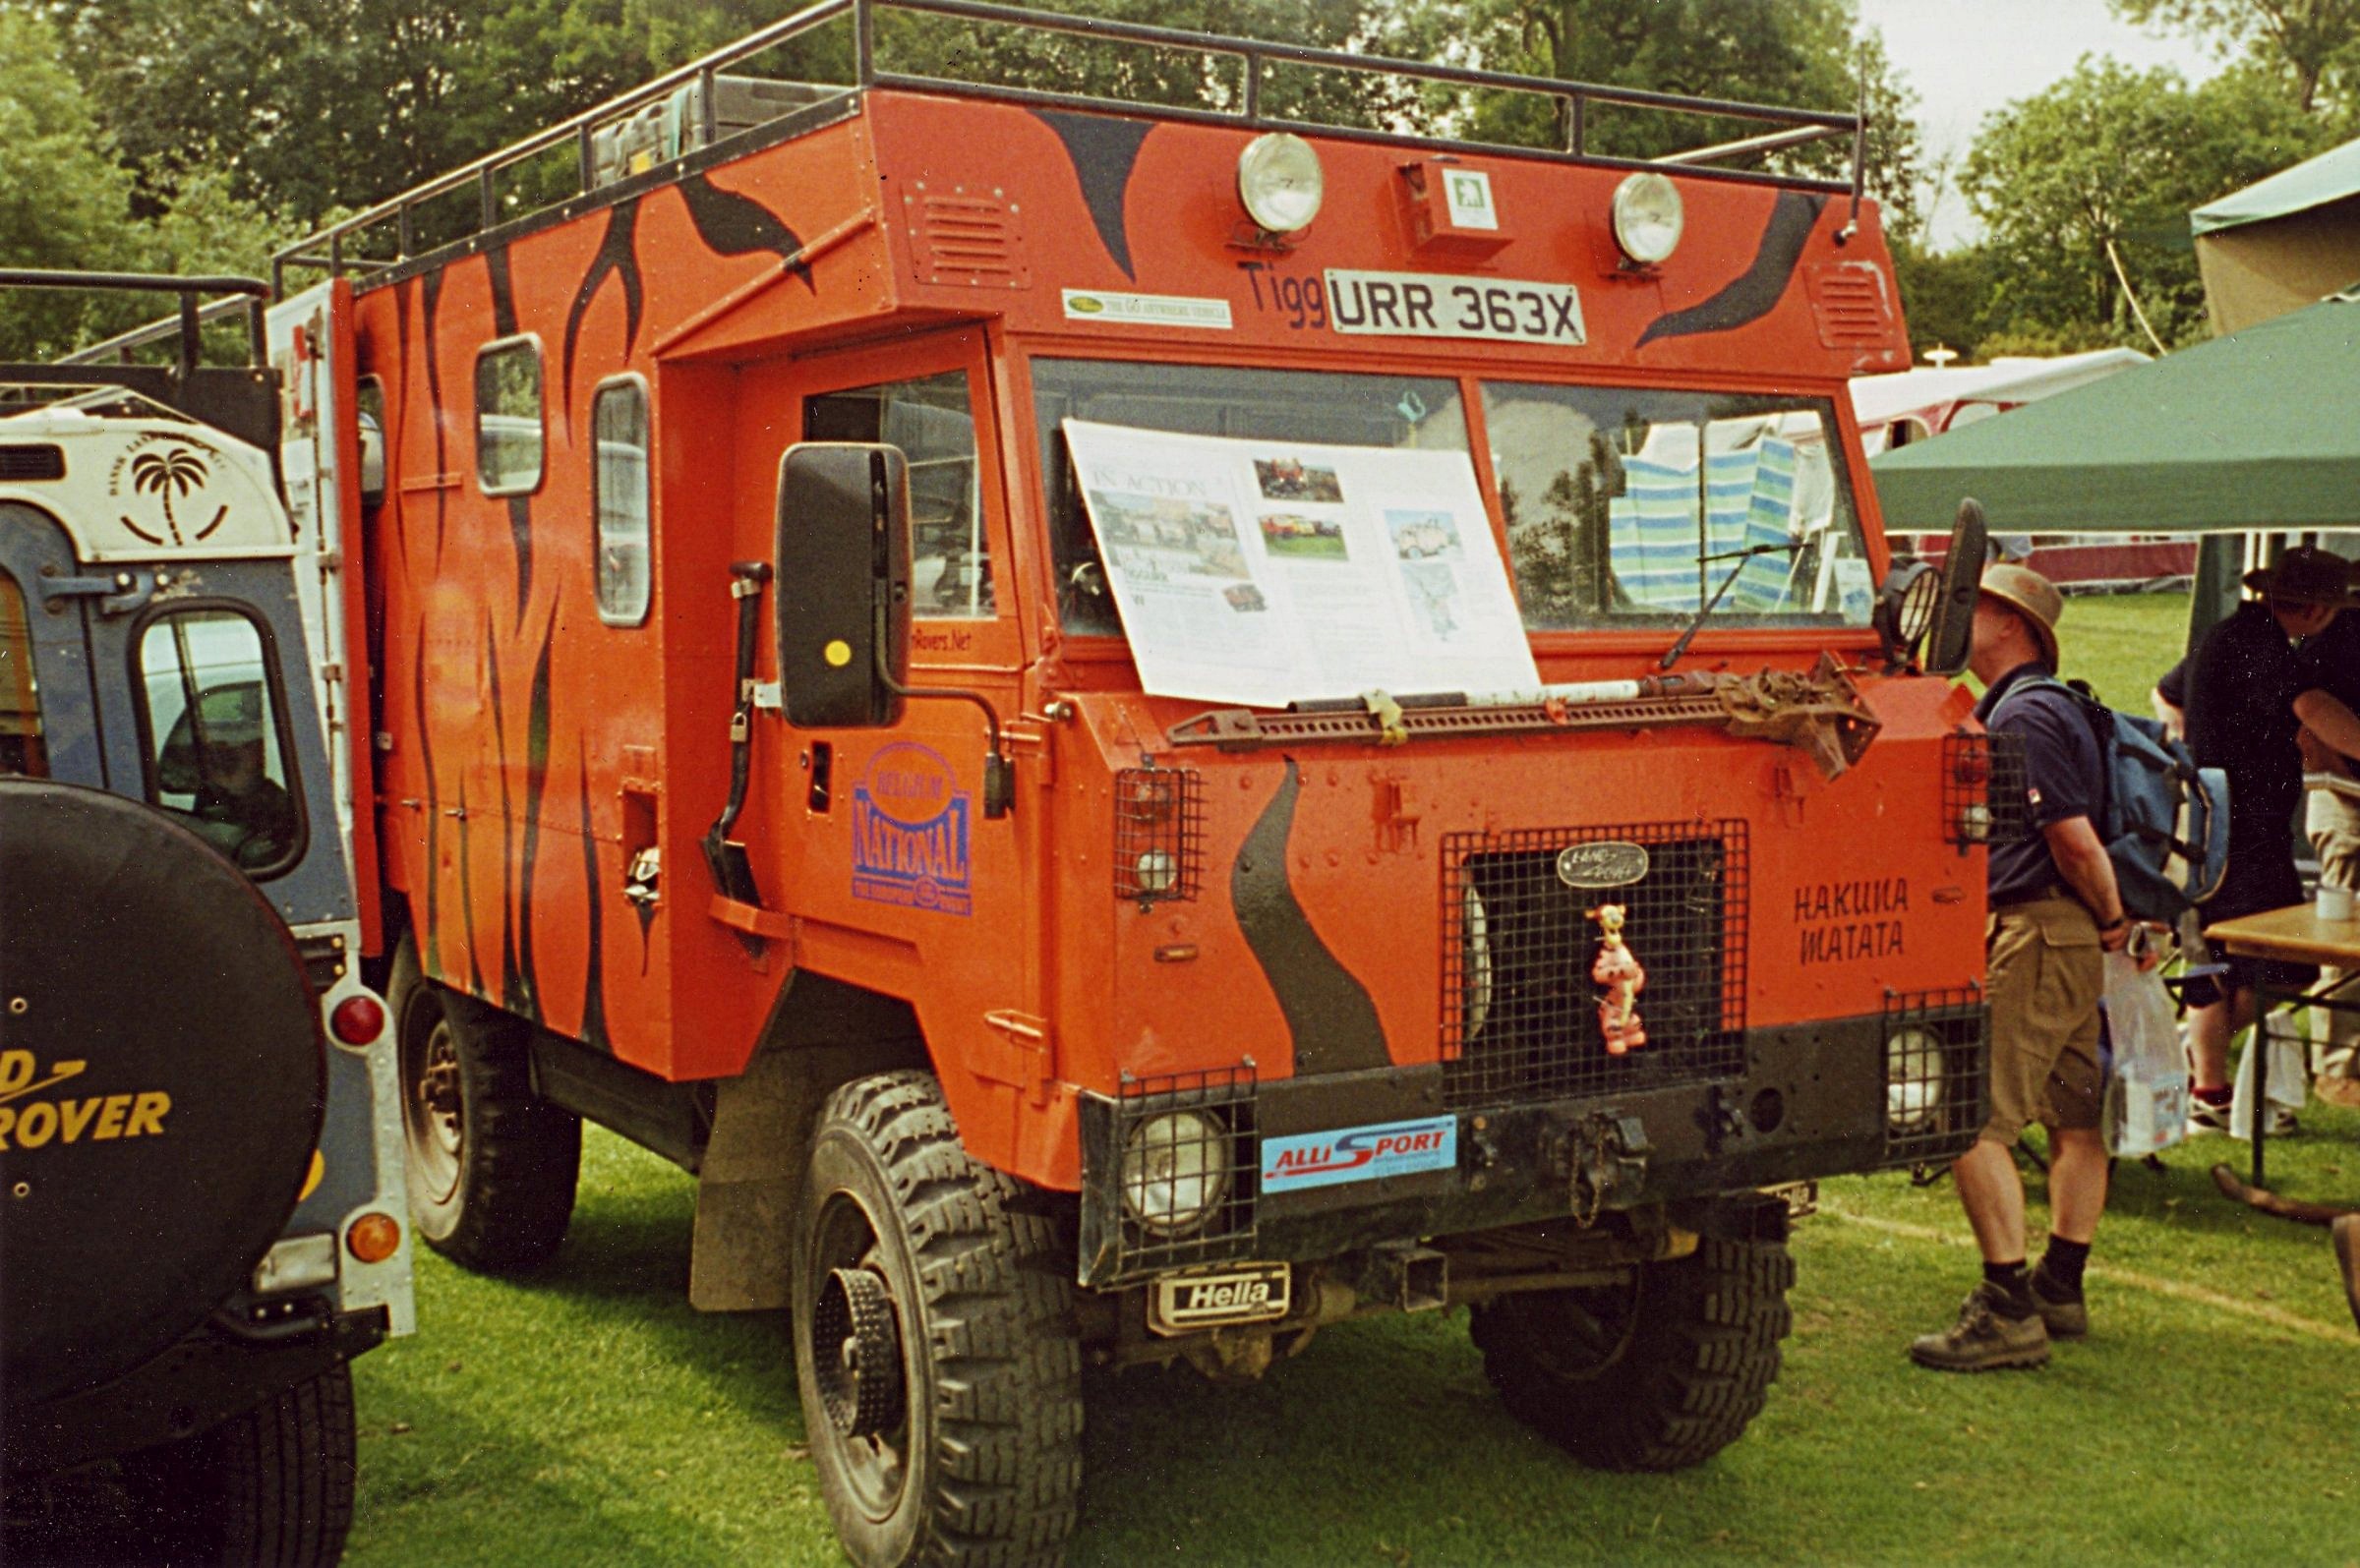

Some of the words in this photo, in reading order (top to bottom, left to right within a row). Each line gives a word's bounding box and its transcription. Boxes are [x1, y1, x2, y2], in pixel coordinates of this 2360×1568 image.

[1329, 279, 1438, 328] URR
[1452, 285, 1580, 339] 363X
[855, 799, 965, 882] NATIONAL
[1794, 877, 1909, 923] HAKUNA
[1800, 920, 1905, 966] MATATA
[1188, 1281, 1269, 1309] Hella
